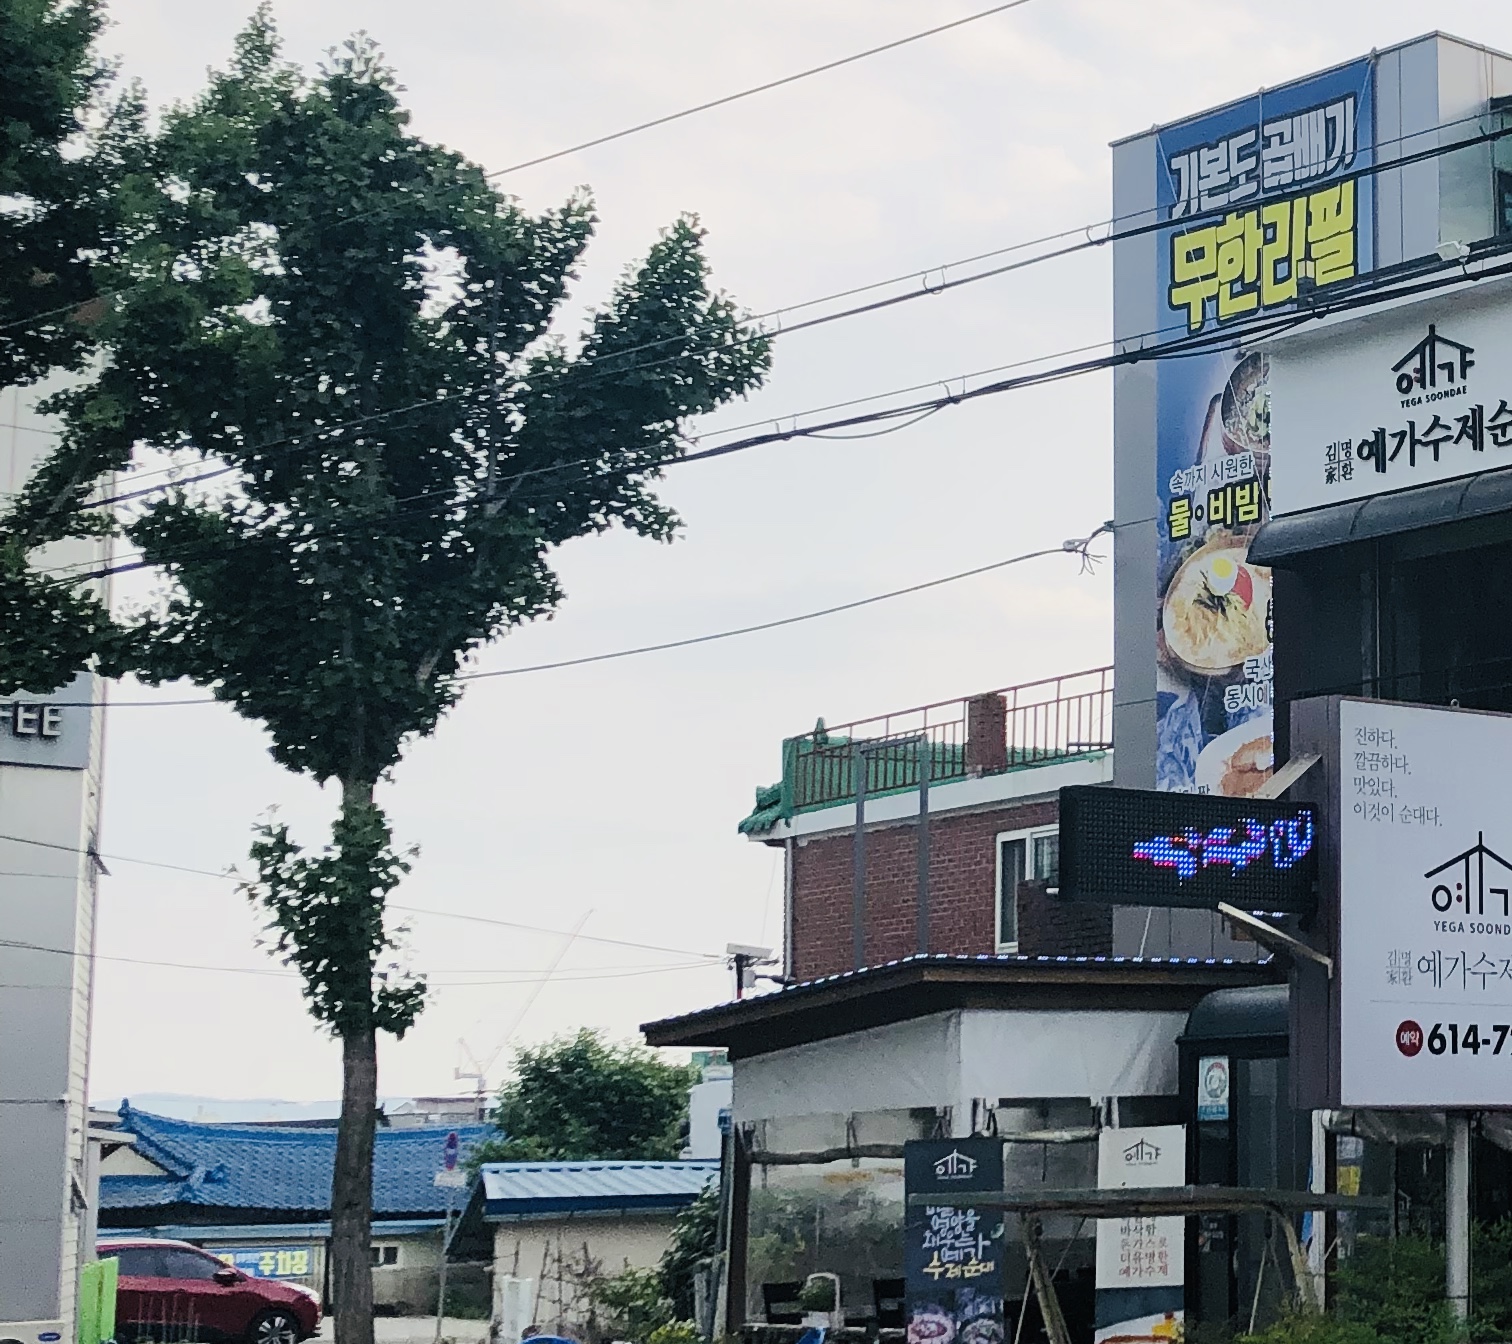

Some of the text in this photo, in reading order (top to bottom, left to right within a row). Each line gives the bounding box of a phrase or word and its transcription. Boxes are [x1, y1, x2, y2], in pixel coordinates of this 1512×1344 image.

[1171, 129, 1257, 220] 기본도
[1171, 179, 1355, 331] 무한리필
[1400, 385, 1467, 409] YEGA SOONDAE
[1171, 455, 1253, 492] 속까지 시원한
[0, 700, 63, 736] EE
[1354, 726, 1398, 749] 진하다.
[1353, 751, 1412, 775] 깔끔하다.
[1353, 775, 1398, 798] 맛있다.
[1353, 801, 1443, 827] 이것이 순대다.
[1434, 920, 1465, 933] YEGA
